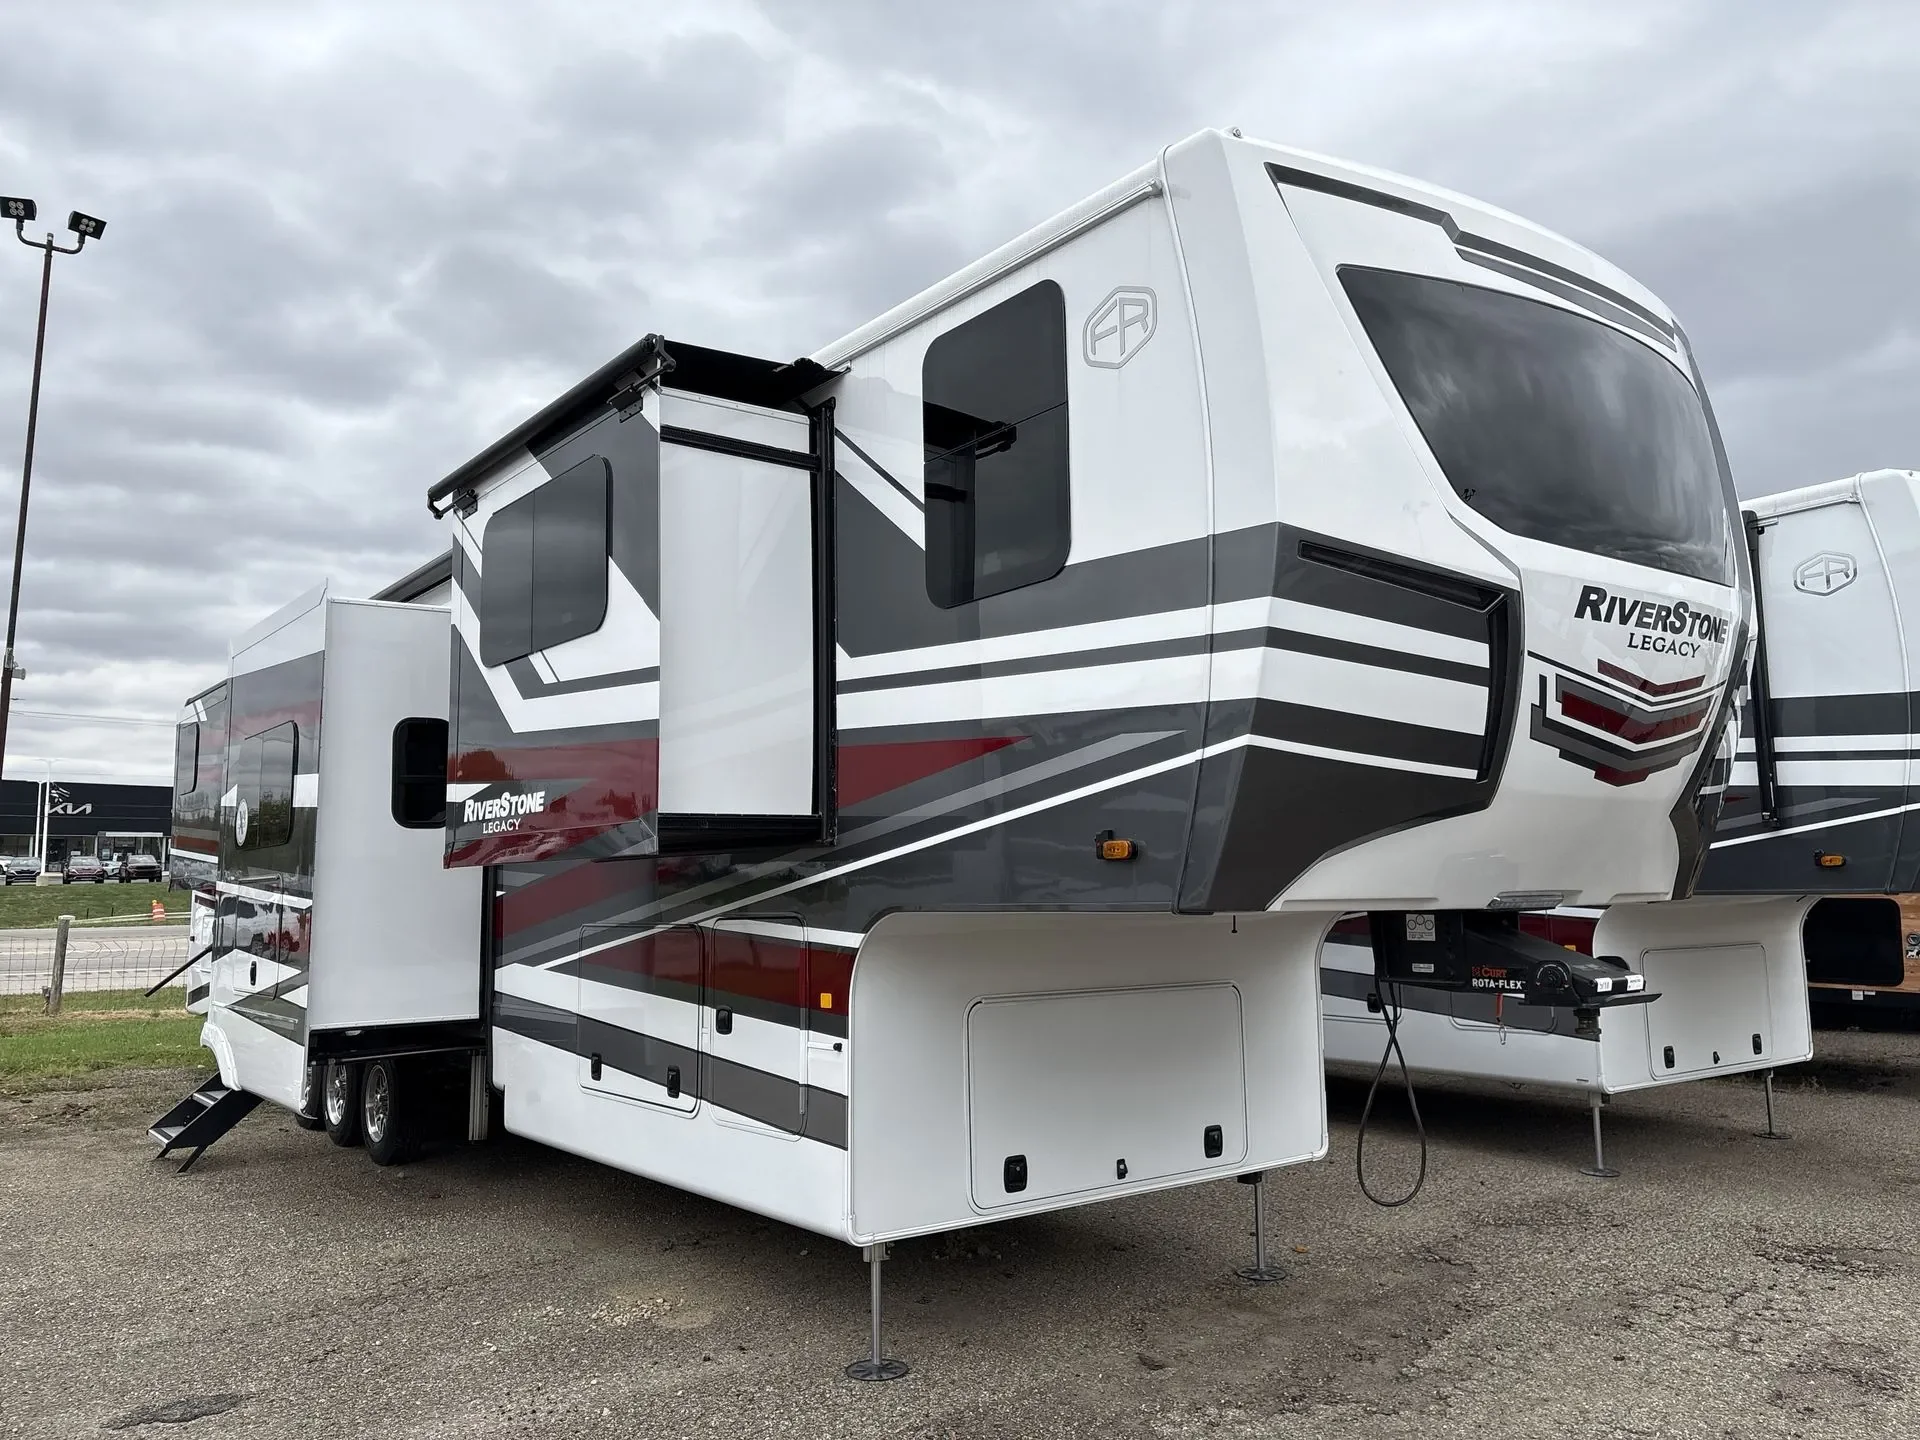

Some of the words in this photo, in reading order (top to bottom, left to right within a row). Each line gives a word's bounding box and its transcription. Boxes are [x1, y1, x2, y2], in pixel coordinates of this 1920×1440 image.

[1574, 585, 1728, 644] RIVERSTONE
[1627, 633, 1701, 658] LEGACY
[463, 791, 546, 823] RIVERSTONE
[482, 819, 521, 834] LEGACY
